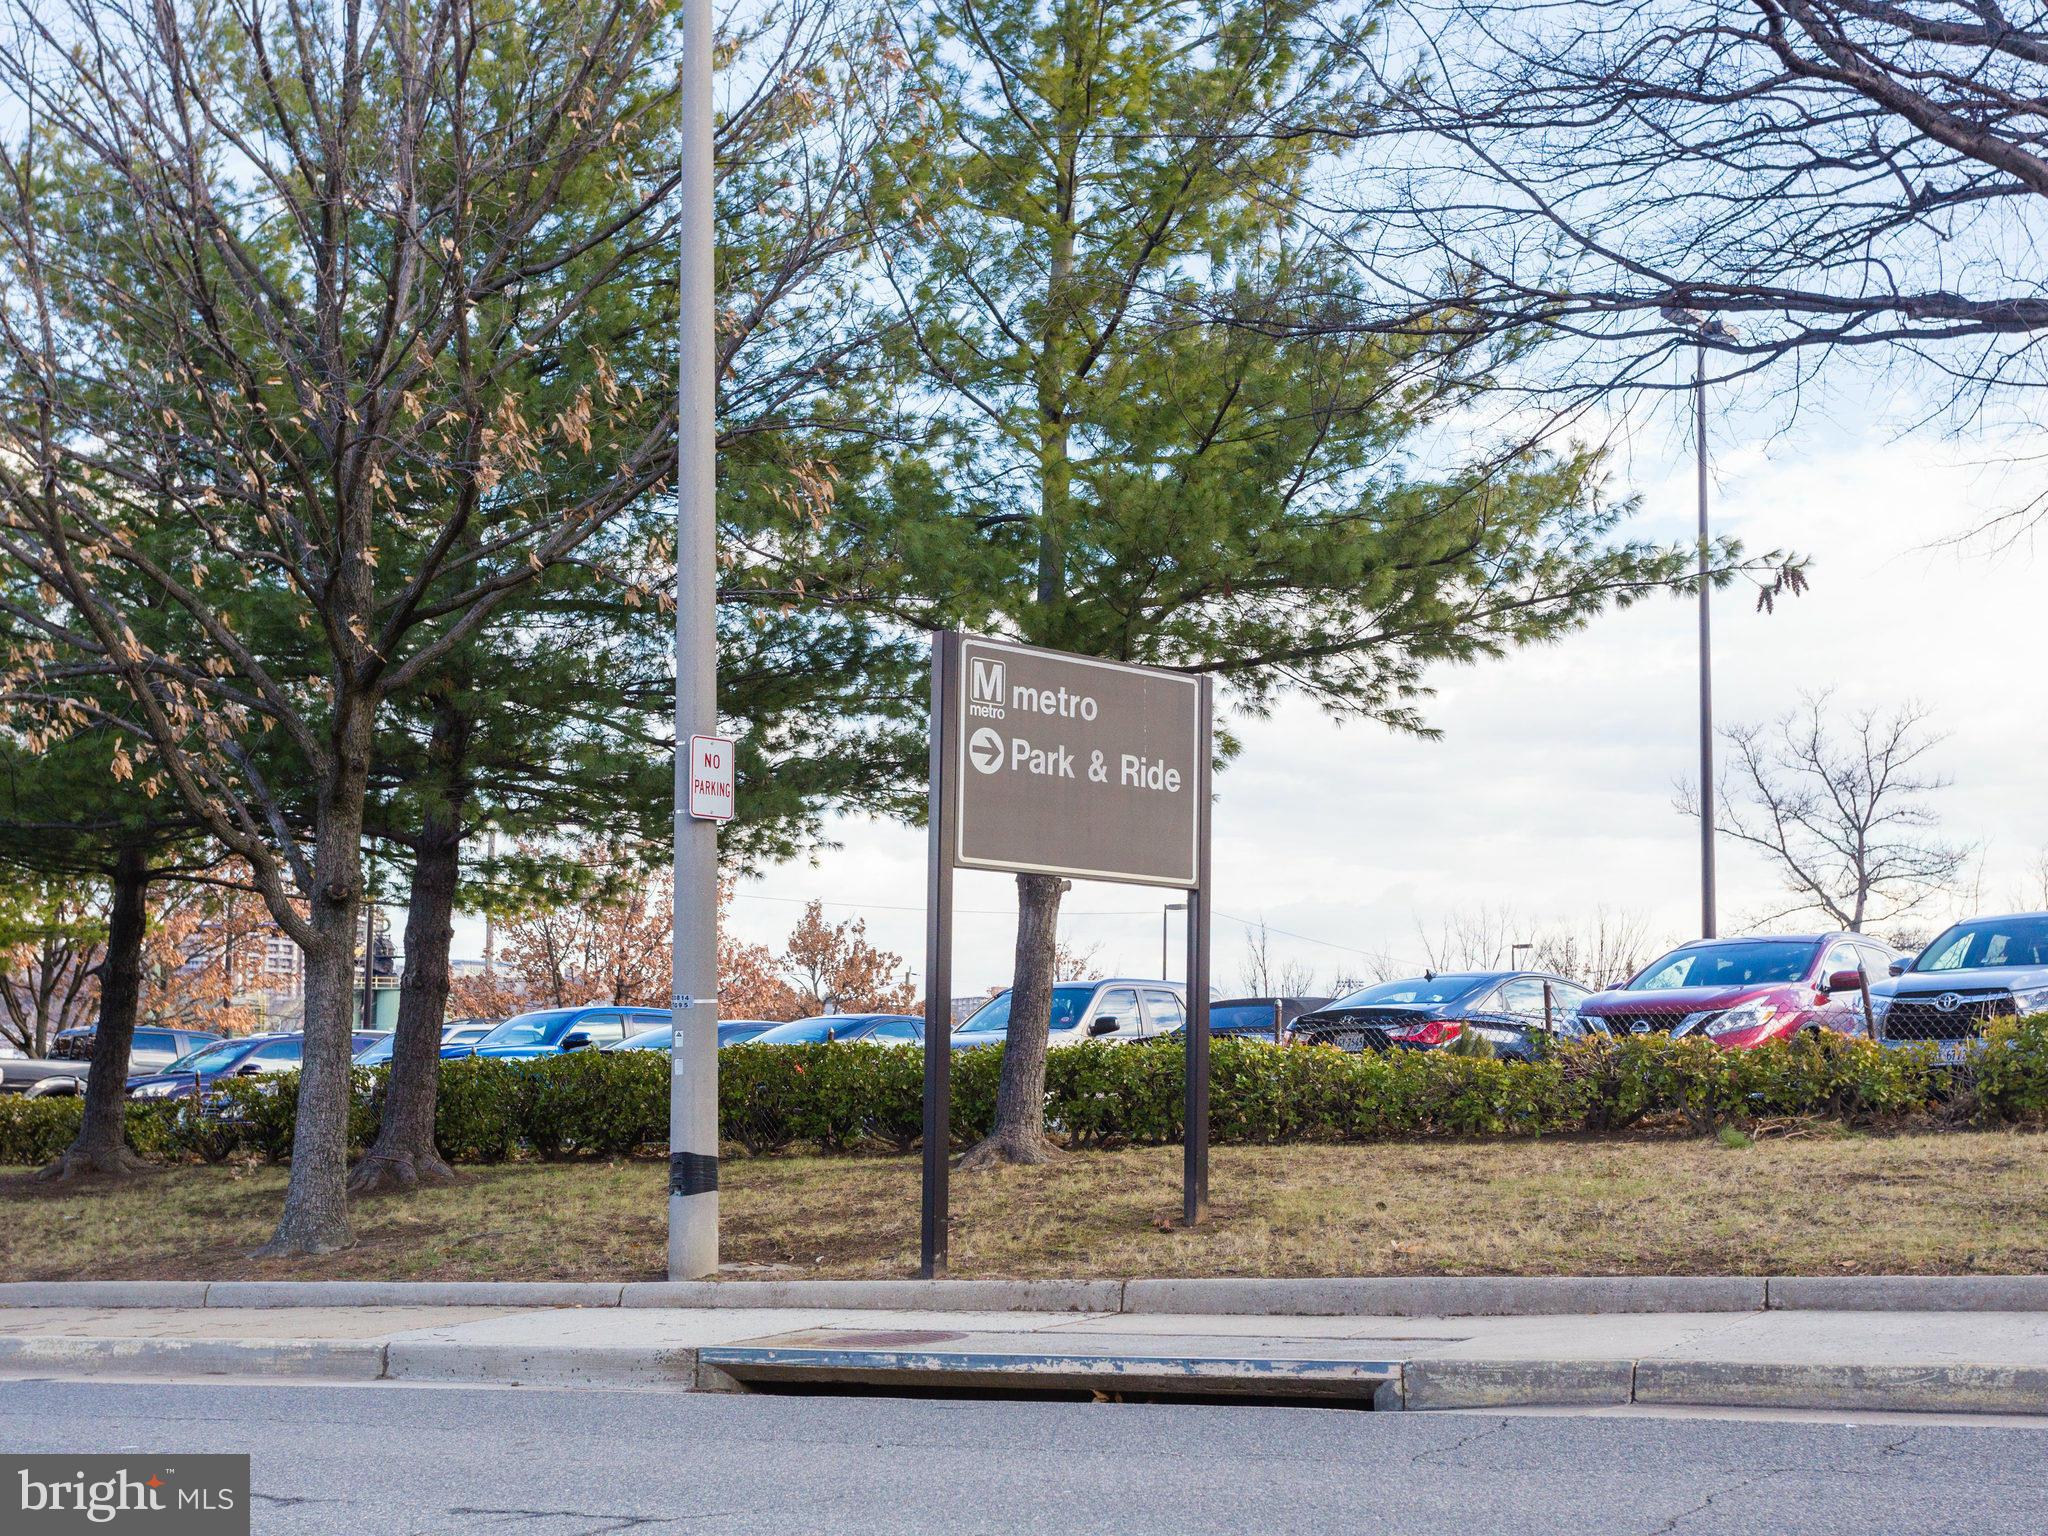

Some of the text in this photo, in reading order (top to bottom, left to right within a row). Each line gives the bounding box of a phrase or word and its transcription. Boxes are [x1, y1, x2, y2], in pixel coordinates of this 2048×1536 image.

[972, 660, 1002, 702] M
[969, 703, 1006, 720] metro
[1012, 684, 1098, 721] metro
[704, 753, 721, 769] NO
[1011, 738, 1182, 793] Park & Ride
[694, 779, 731, 798] PARKING
